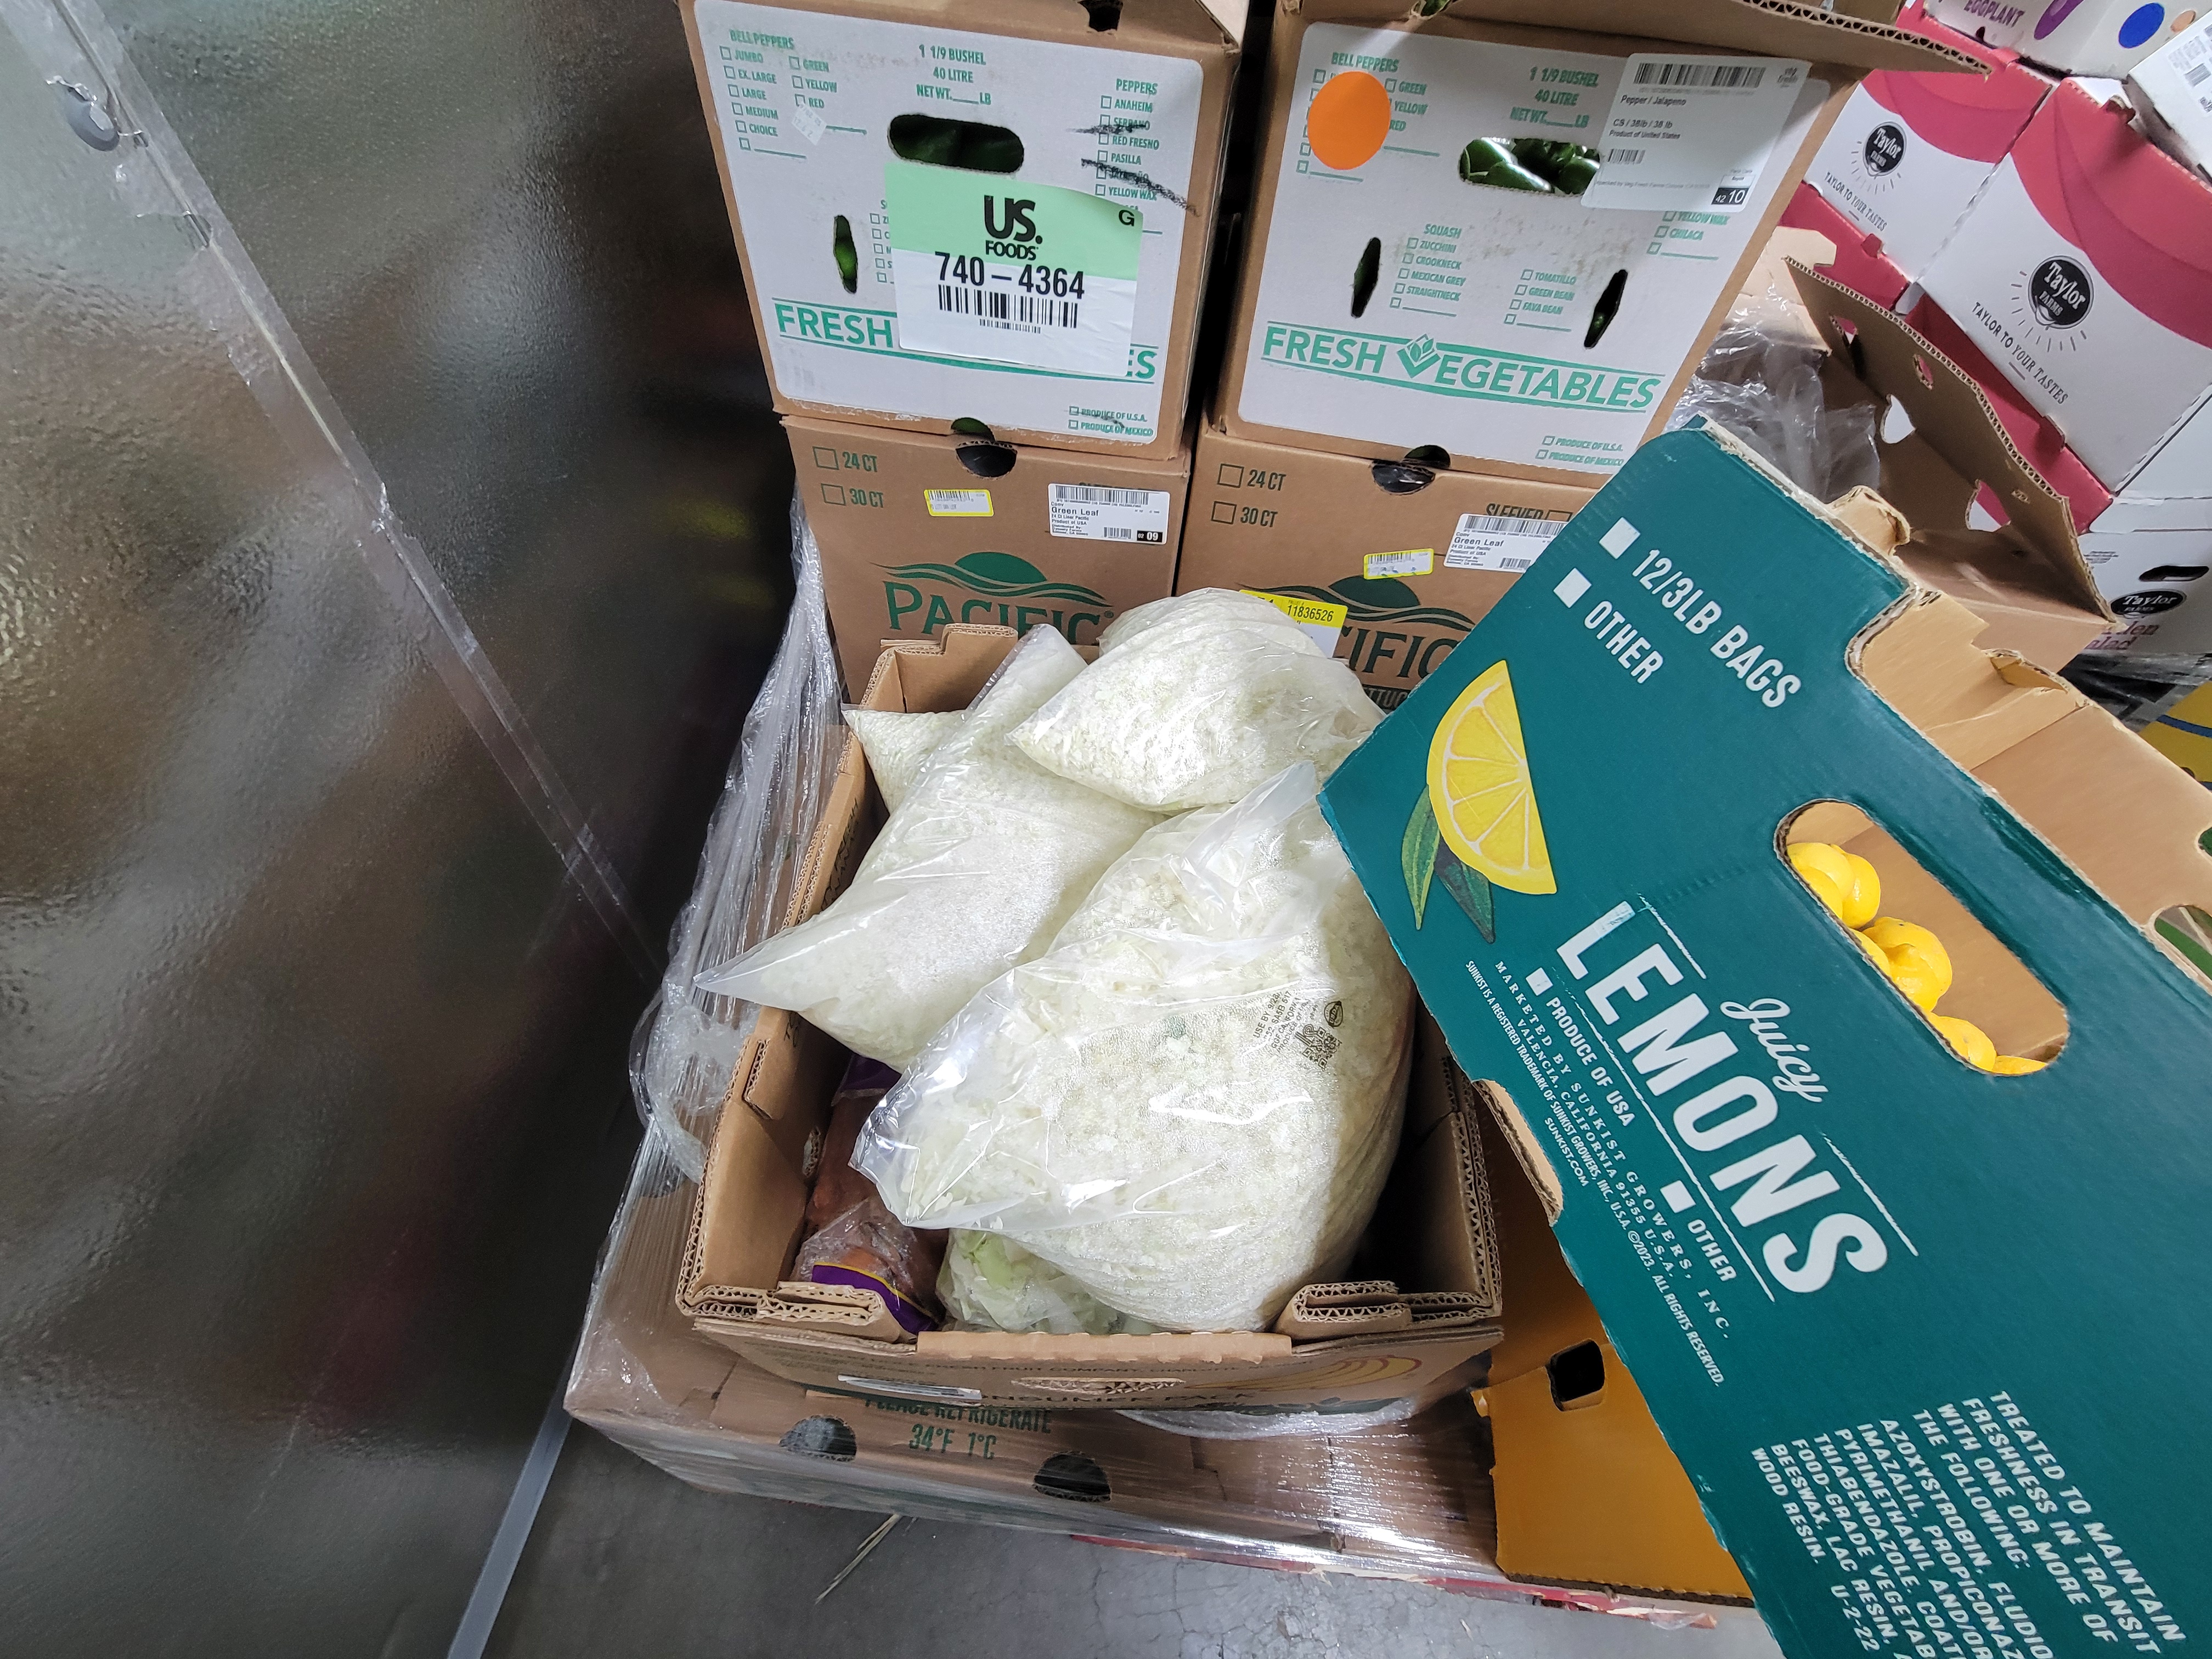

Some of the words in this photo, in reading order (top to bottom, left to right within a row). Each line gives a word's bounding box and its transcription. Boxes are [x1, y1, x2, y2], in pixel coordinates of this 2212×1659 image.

[752, 32, 795, 50] PEPPERS
[735, 50, 764, 63] JUMBO
[803, 58, 829, 72] GREEN
[949, 48, 986, 66] BUSHEL
[1356, 54, 1400, 73] PEPPERS
[752, 71, 777, 84] LARGE
[933, 66, 946, 80] 40
[948, 68, 974, 83] LITRE
[1559, 70, 1599, 88] BUSHEL
[741, 87, 767, 100] LARGE
[805, 78, 837, 93] YELLOW
[1116, 78, 1158, 95] PEPPERS
[1399, 81, 1427, 96] GREEN
[809, 97, 825, 109] RED
[979, 92, 991, 105] LB
[1114, 99, 1153, 113] ANAHEIM
[1534, 88, 1550, 103] 40
[1550, 91, 1579, 106] LITRE
[1621, 94, 1647, 106] Pepper
[1652, 96, 1687, 106] Jalapeno
[745, 105, 778, 120] MEDIUM
[1394, 100, 1429, 115] YELLOW
[749, 123, 778, 137] CHOICE
[1613, 118, 1625, 127] CS
[1609, 129, 1633, 138] Product
[1112, 136, 1128, 146] RED
[1129, 137, 1160, 150] FRESNO
[1873, 127, 1901, 159] Taylor
[1111, 153, 1142, 165] PASILLA
[1109, 186, 1138, 199] YELLOW
[1715, 194, 1726, 203] 42
[1728, 189, 1746, 204] 10
[1825, 171, 1845, 195] TAYLOR
[1851, 195, 1867, 215] YOUR
[1865, 208, 1888, 232] TASTES
[1118, 209, 1135, 227] G
[1424, 223, 1463, 239] SQUASH
[985, 240, 1037, 261] FOODS
[1419, 240, 1457, 253] ZUCCHINI
[1415, 256, 1463, 270] CROOKNECK
[1411, 270, 1445, 284] MEXICAN
[1445, 275, 1467, 287] GREY
[1534, 272, 1577, 286] TOMATILLO
[2044, 261, 2086, 310] Taylor
[1406, 286, 1462, 302] STRAIGHTNECK
[1528, 287, 1554, 299] GREEN
[1522, 302, 1542, 313] FAVA
[1542, 304, 1564, 315] BEAN
[774, 303, 894, 348] FRESH
[1262, 326, 1387, 374] FRESH
[1972, 302, 2002, 337] TAYLOR
[2000, 331, 2014, 348] TO
[2011, 344, 2036, 373] YOUR
[2033, 367, 2069, 404] TASTES
[1081, 408, 1115, 419] PRODUCE
[1081, 421, 1114, 433] PRODUCE
[1125, 426, 1154, 437] MEXICO
[1555, 438, 1593, 449] PRODUCE
[842, 450, 861, 470] 24
[861, 453, 878, 473] CT
[1548, 452, 1585, 463] PRODUCE
[1246, 469, 1266, 488] 24
[1266, 471, 1286, 492] CT
[849, 488, 867, 506] 30
[868, 490, 884, 509] CT
[1052, 506, 1077, 515] Green
[1081, 508, 1099, 516] Leaf
[1238, 506, 1259, 525] 30
[1260, 508, 1278, 529] CT
[1146, 532, 1159, 541] 09
[1454, 537, 1481, 545] Green
[1483, 538, 1505, 548] Leaf
[2123, 595, 2178, 607] Taylor
[1287, 604, 1334, 623] 11836526
[1632, 549, 1722, 635] 12/3LB
[1710, 624, 1802, 708] BAGS
[1584, 600, 1663, 684] OTHER
[1252, 1022, 1266, 1039] USE
[1261, 1010, 1271, 1022] BY
[1276, 1021, 1299, 1053] PRODUCE
[1719, 997, 1830, 1104] Juicy
[1545, 996, 1598, 1066] PRODUCE
[1590, 1066, 1613, 1087] OF
[1605, 1090, 1635, 1127] USA
[1556, 900, 1888, 1294] LEMONS
[1494, 961, 1553, 1047] MARKETED
[1553, 1053, 1572, 1075] BY
[1570, 1082, 1627, 1161] SUNKIST
[1626, 1171, 1692, 1279] GROWERS,
[1697, 1288, 1730, 1339] INC.
[1517, 1018, 1561, 1089] VALENCIA,
[1560, 1091, 1618, 1179] CALIFORNIA
[1615, 1182, 1646, 1224] 91355
[1644, 1228, 1675, 1278] U.S.A.
[1544, 1117, 1590, 1187] SUNKIST.COM
[1465, 960, 1488, 990] SUNKIST
[1491, 1002, 1521, 1046] REGISTERED
[1515, 1043, 1550, 1091] TRADEMARK
[1543, 1090, 1557, 1102] OF
[1550, 1101, 1578, 1136] SUNKIST
[1571, 1135, 1602, 1181] GROWERS,
[1651, 1274, 1671, 1294] ALL
[1663, 1293, 1694, 1331] RIGHTS
[1685, 1330, 1725, 1387] RESERVED.
[1687, 1218, 1737, 1282] OTHER
[909, 1423, 956, 1453] 34°F
[968, 1432, 997, 1460] 1°C
[1857, 1423, 1926, 1519] IMAZALIL,
[1791, 1438, 1876, 1558] FOOD-GRADE
[1879, 1419, 1994, 1575] AZOXYSTROBIN,
[1912, 1408, 1950, 1447] THE
[1940, 1451, 2031, 1570] FOLLOWING:
[1751, 1447, 1789, 1497] WOOD
[1781, 1502, 1826, 1564] RESIN.
[1833, 1427, 1936, 1572] PYRIMETHANIL
[1814, 1432, 1922, 1594] THIABENDAZOLE.
[1989, 1390, 2066, 1480] TREATED
[2058, 1485, 2092, 1515] TO
[2083, 1522, 2186, 1641] MAINTAIN
[1937, 1403, 1983, 1451] WITH
[1974, 1456, 2017, 1499] ONE
[2007, 1504, 2041, 1535] OR
[2031, 1541, 2092, 1606] MORE
[2083, 1613, 2119, 1644] OF
[1961, 1397, 2058, 1514] FRESHNESS
[2049, 1520, 2083, 1546] IN
[2074, 1551, 2162, 1654] TRANSIT
[1770, 1443, 1831, 1531] BEESWAX,
[1825, 1536, 1858, 1572] LAC
[1850, 1578, 1899, 1645] RESIN,
[1830, 1584, 1881, 1652] U-2-22
